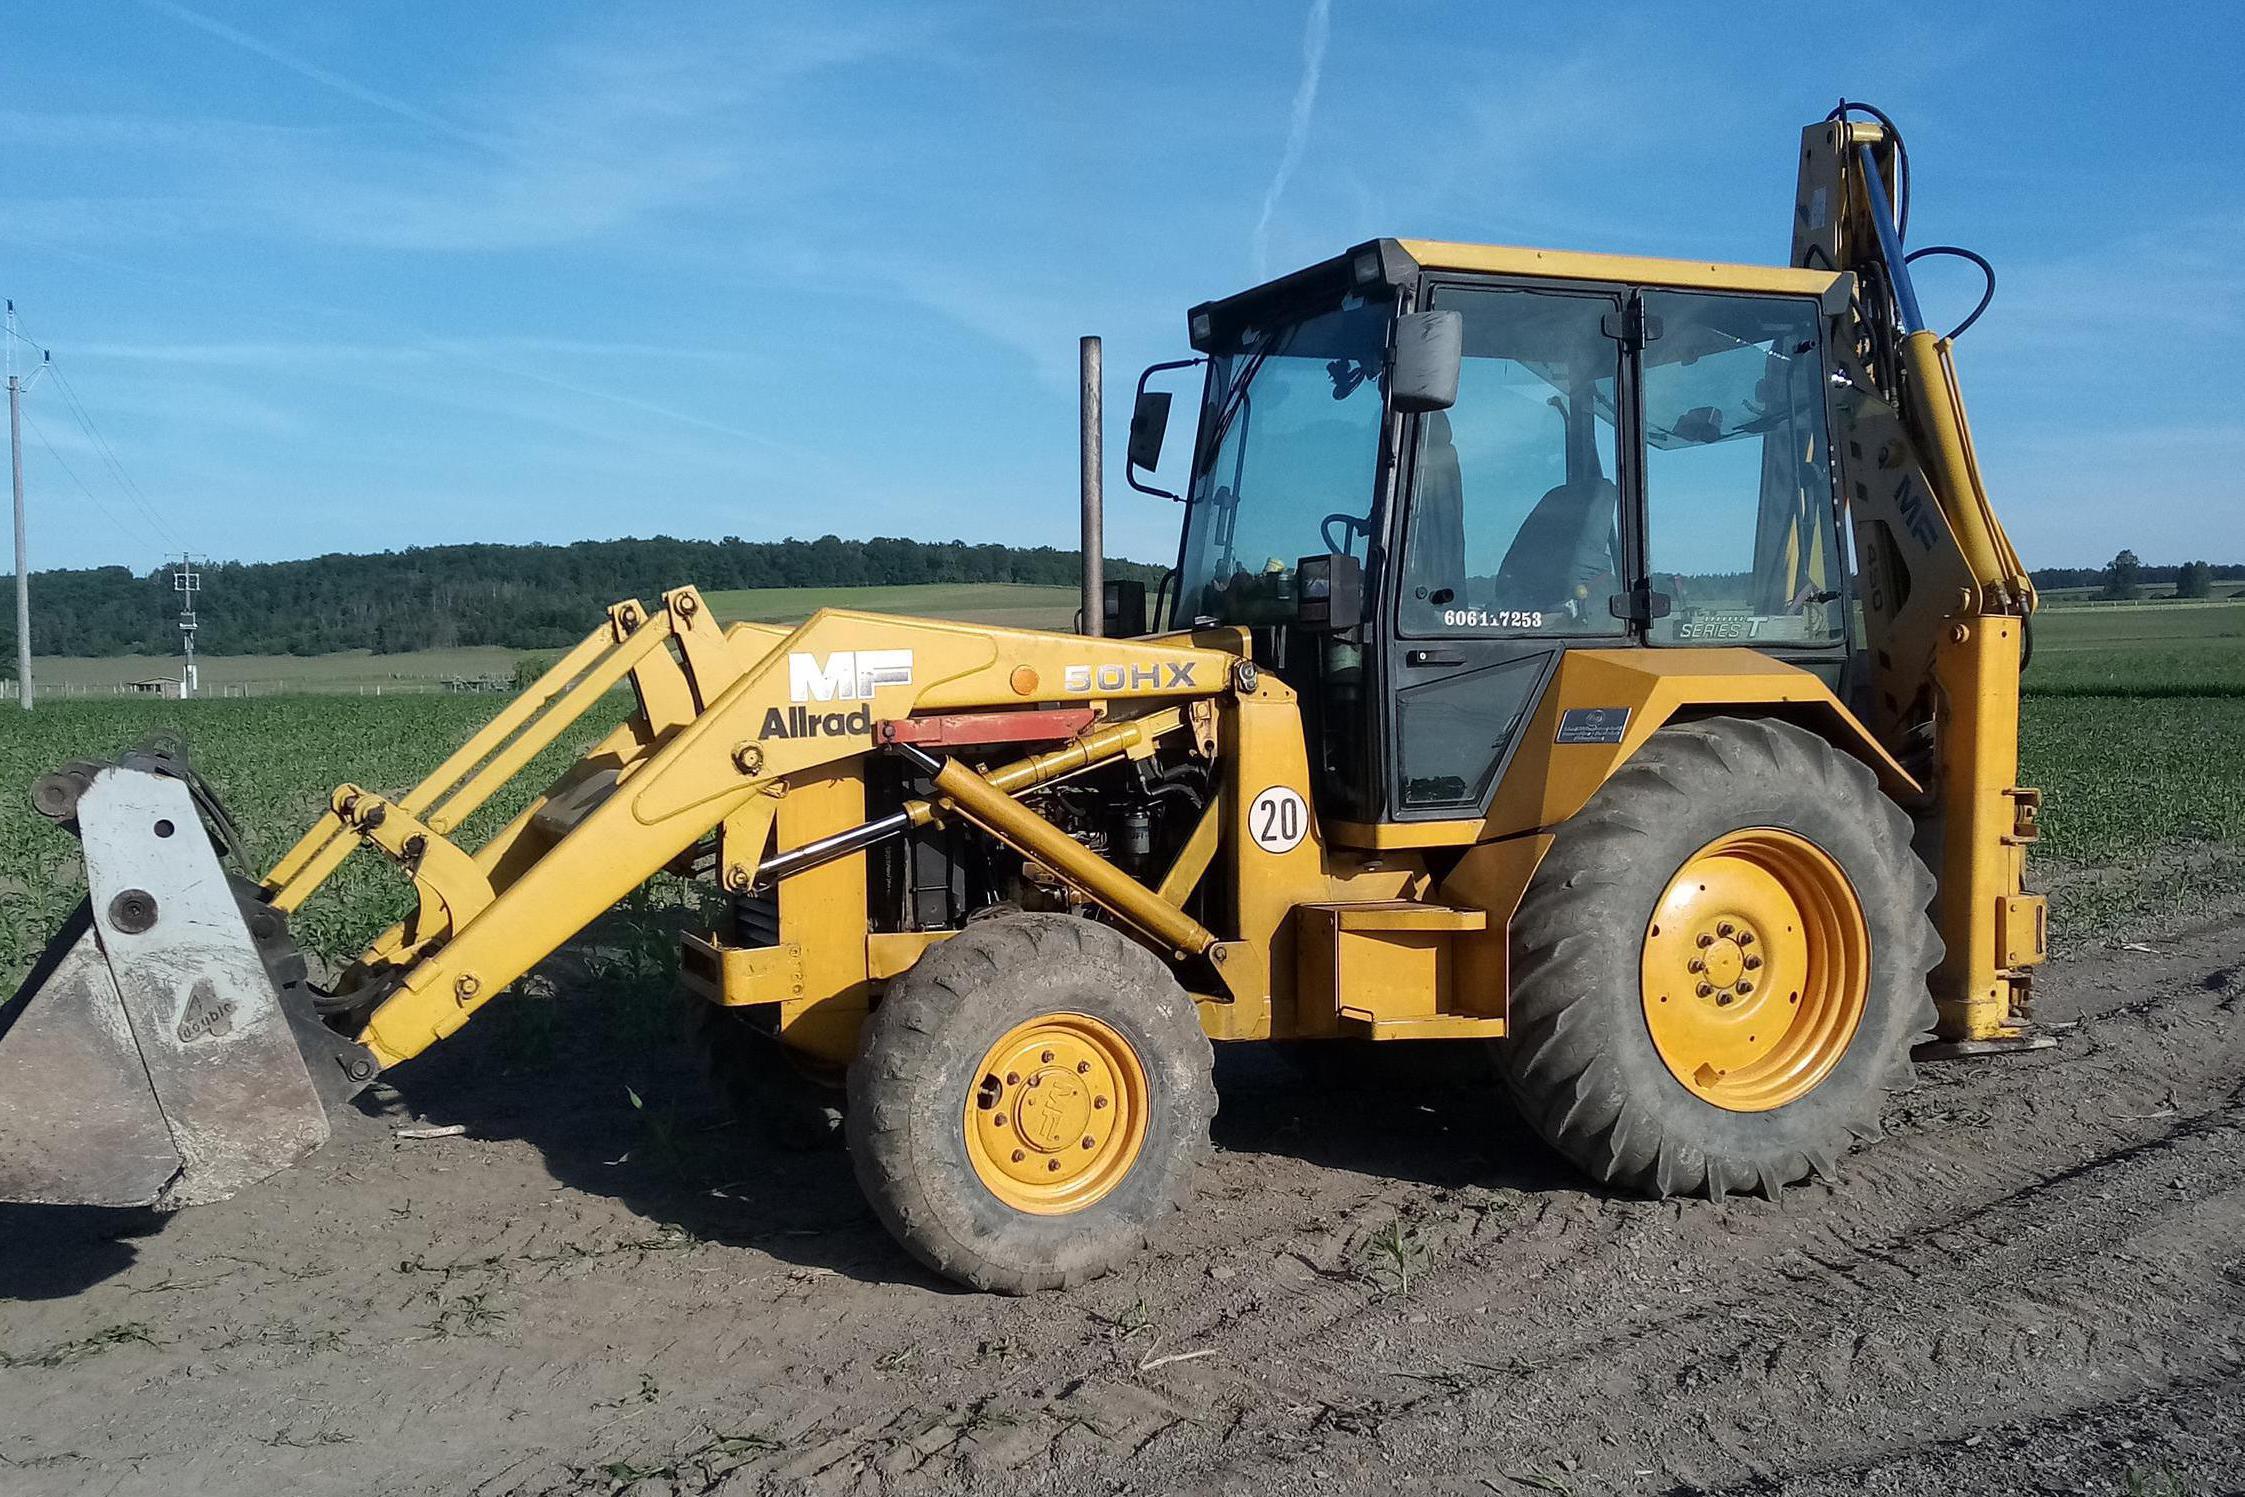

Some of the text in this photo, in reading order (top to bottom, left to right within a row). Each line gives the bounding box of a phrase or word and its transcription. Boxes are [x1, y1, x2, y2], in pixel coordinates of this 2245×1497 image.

[1680, 616, 1768, 638] SERIES T
[788, 649, 913, 702] MF
[1064, 662, 1197, 692] 50HX
[760, 703, 871, 740] Allrad
[1261, 798, 1297, 841] 20
